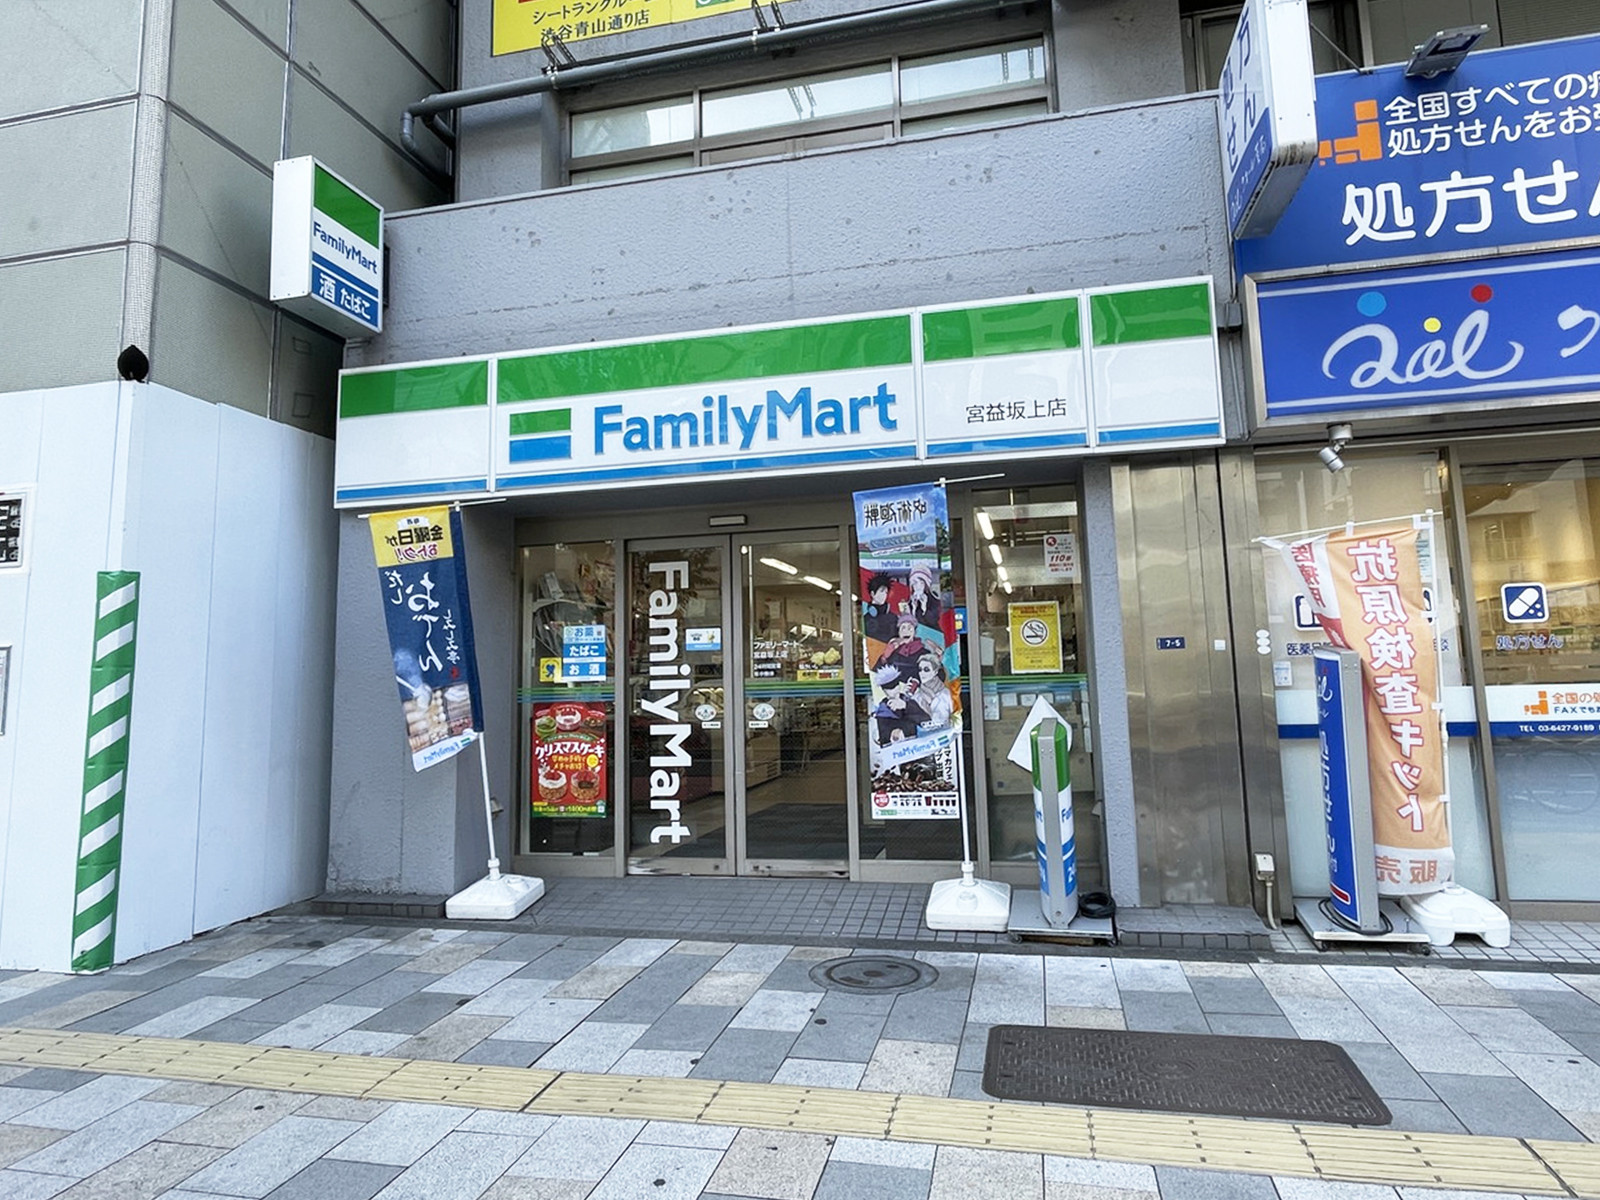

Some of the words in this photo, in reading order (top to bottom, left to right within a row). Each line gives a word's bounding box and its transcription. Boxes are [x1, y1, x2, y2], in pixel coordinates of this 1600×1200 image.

[1342, 159, 1600, 246] 処方せ
[313, 221, 378, 275] FamilyMart
[319, 272, 336, 303] 酒
[340, 287, 371, 320] たばこ
[594, 382, 898, 455] FamilyMart
[965, 398, 1067, 424] 宮益坂上店
[569, 645, 599, 656] たばこ
[753, 639, 801, 649] ファミリーマート
[1495, 634, 1564, 650] 処方せん
[569, 664, 600, 675] お酒
[640, 561, 692, 843] FamilyMart
[535, 742, 605, 760] クリスマスケーキ
